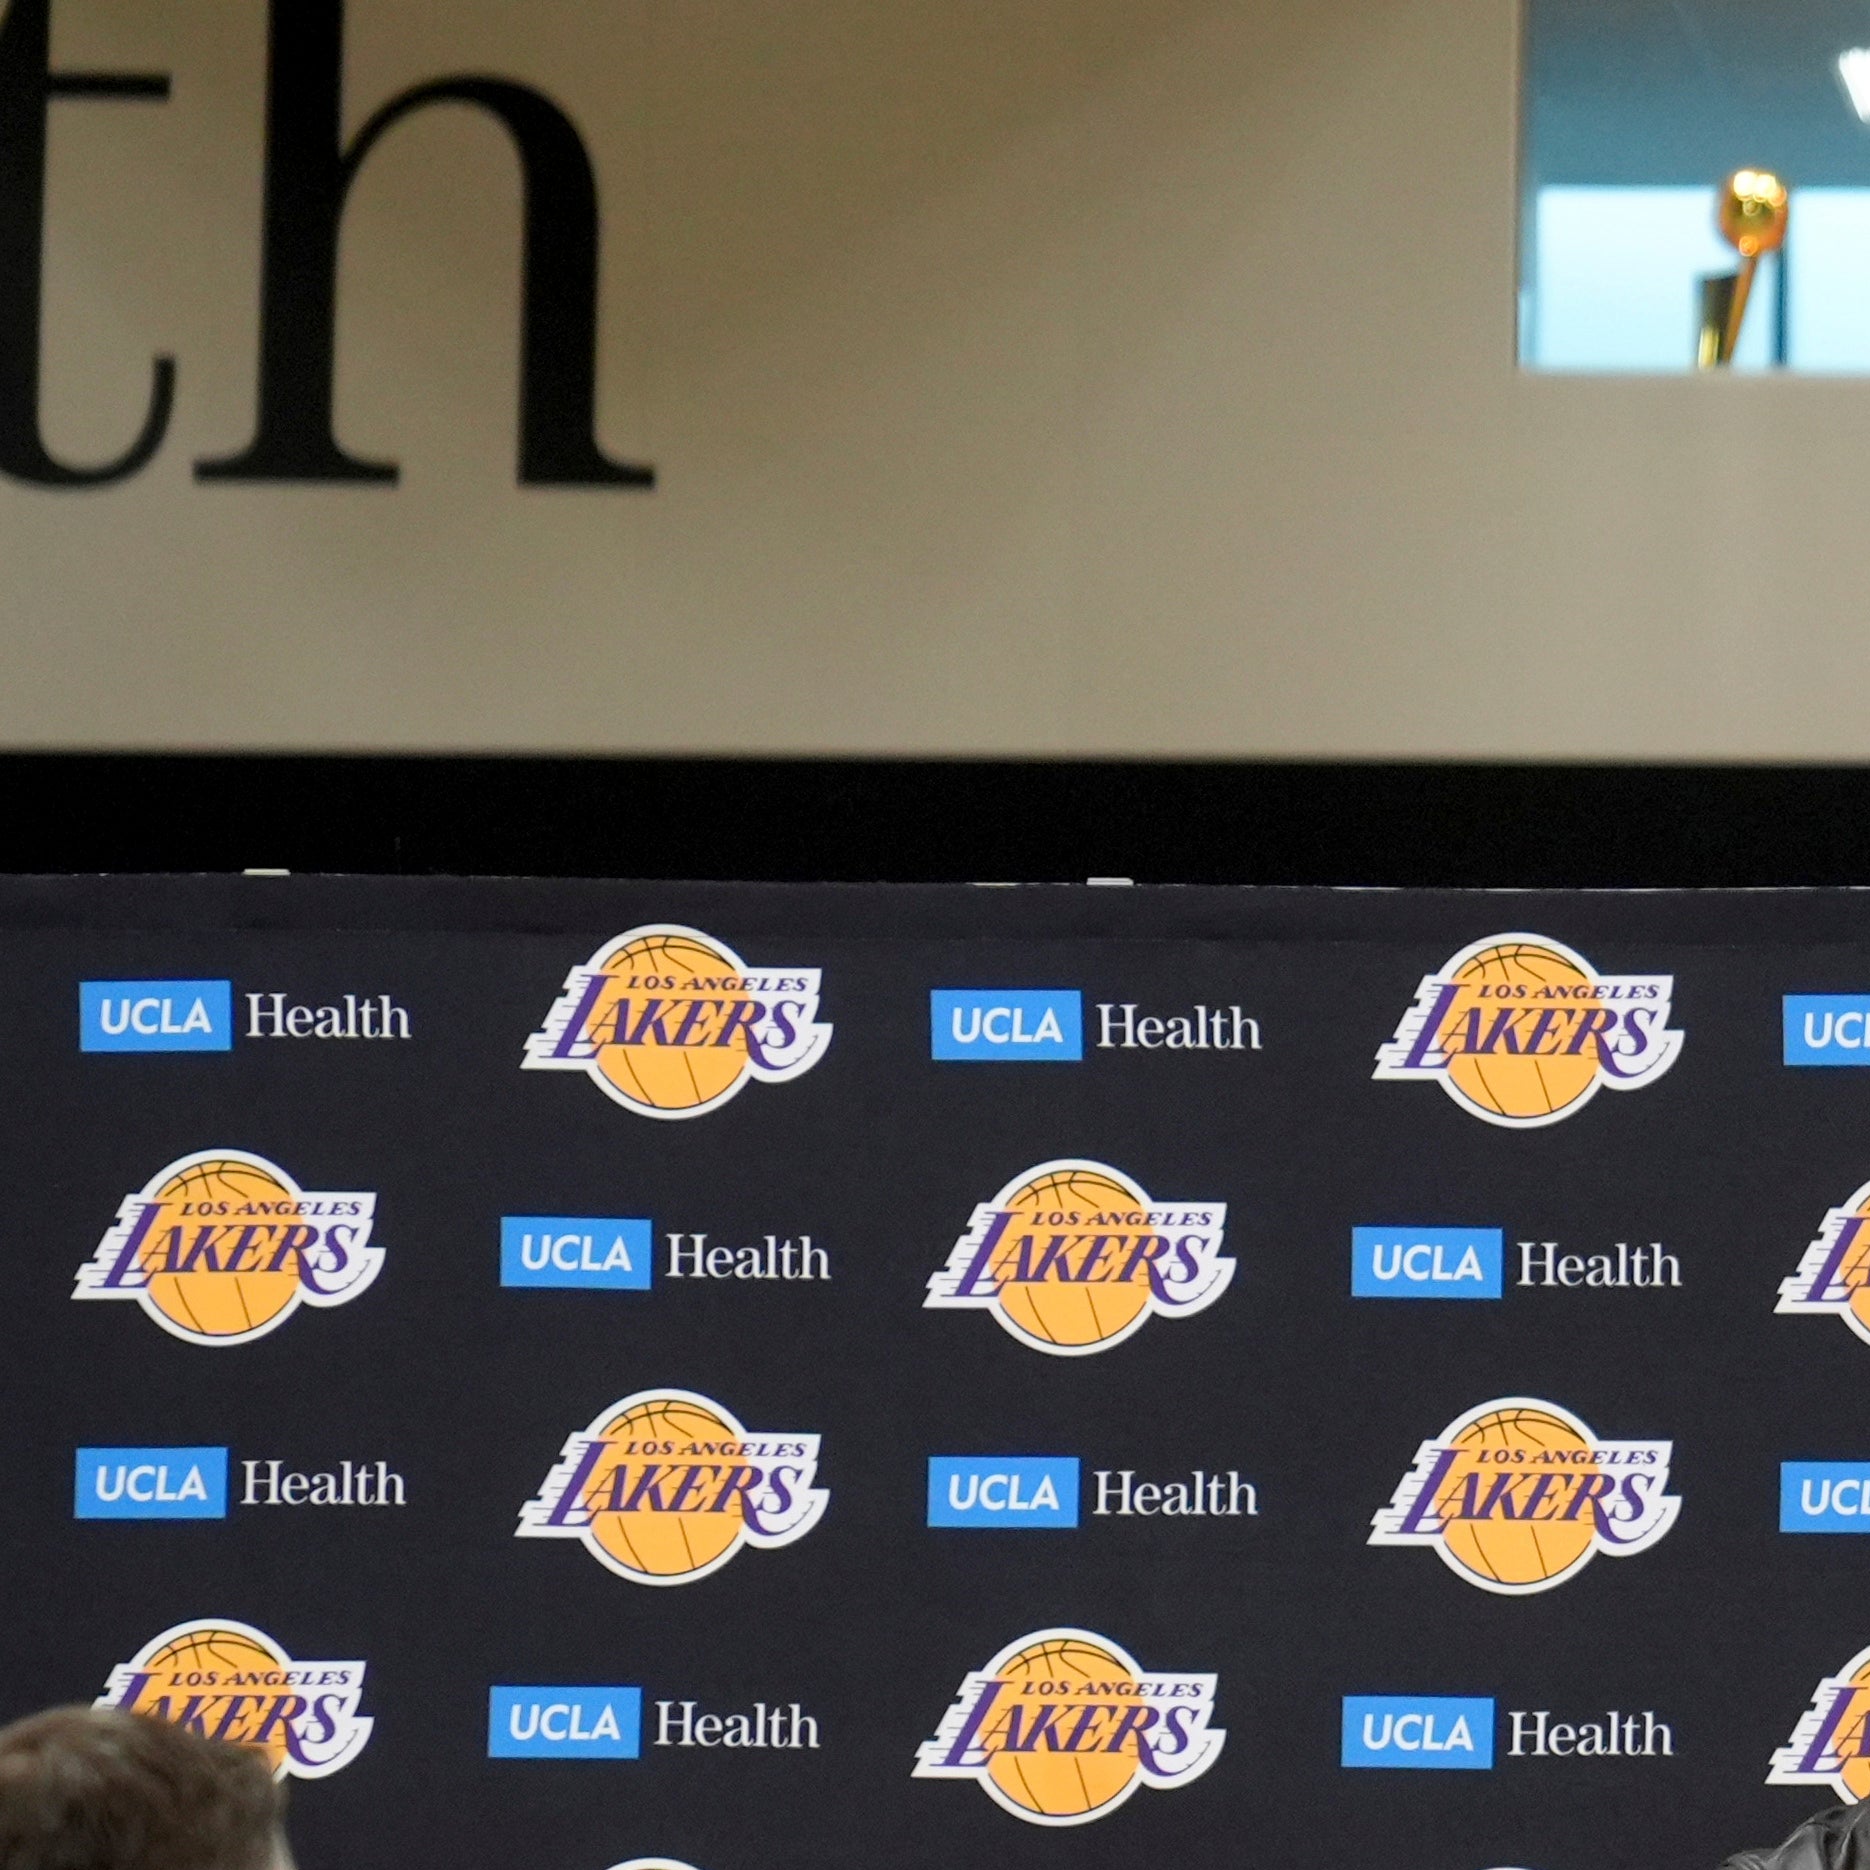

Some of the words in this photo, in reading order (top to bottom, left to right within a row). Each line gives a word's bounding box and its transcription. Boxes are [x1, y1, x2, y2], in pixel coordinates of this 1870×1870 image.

[1477, 982, 1528, 1000] LOS
[1532, 982, 1661, 1001] ANGELES
[101, 997, 212, 1034] UCLA
[246, 995, 411, 1037] Health
[544, 973, 812, 1071] LAKERS
[952, 1006, 1063, 1044] UCLA
[1097, 1005, 1262, 1049] Health
[1395, 983, 1663, 1078] LAKERS
[179, 1200, 230, 1217] LOS
[234, 1199, 363, 1217] ANGELES
[96, 1201, 364, 1295] LAKERS
[522, 1233, 632, 1273] UCLA
[667, 1234, 831, 1280] Health
[948, 1210, 1215, 1306] LAKERS
[1373, 1244, 1483, 1282] UCLA
[1518, 1242, 1682, 1287] Health
[1476, 1447, 1527, 1465] LOS
[1531, 1447, 1660, 1467] ANGELES
[96, 1464, 207, 1502] UCLA
[241, 1461, 407, 1504] Health
[540, 1439, 809, 1537] LAKERS
[949, 1474, 1060, 1511] UCLA
[1094, 1471, 1258, 1515] Health
[1392, 1447, 1661, 1545] LAKERS
[1020, 1679, 1072, 1697] LOS
[1075, 1679, 1204, 1699] ANGELES
[510, 1703, 621, 1742] UCLA
[655, 1702, 820, 1747] Health
[936, 1679, 1205, 1777] LAKERS
[1363, 1713, 1474, 1751] UCLA
[1508, 1711, 1674, 1756] Health
